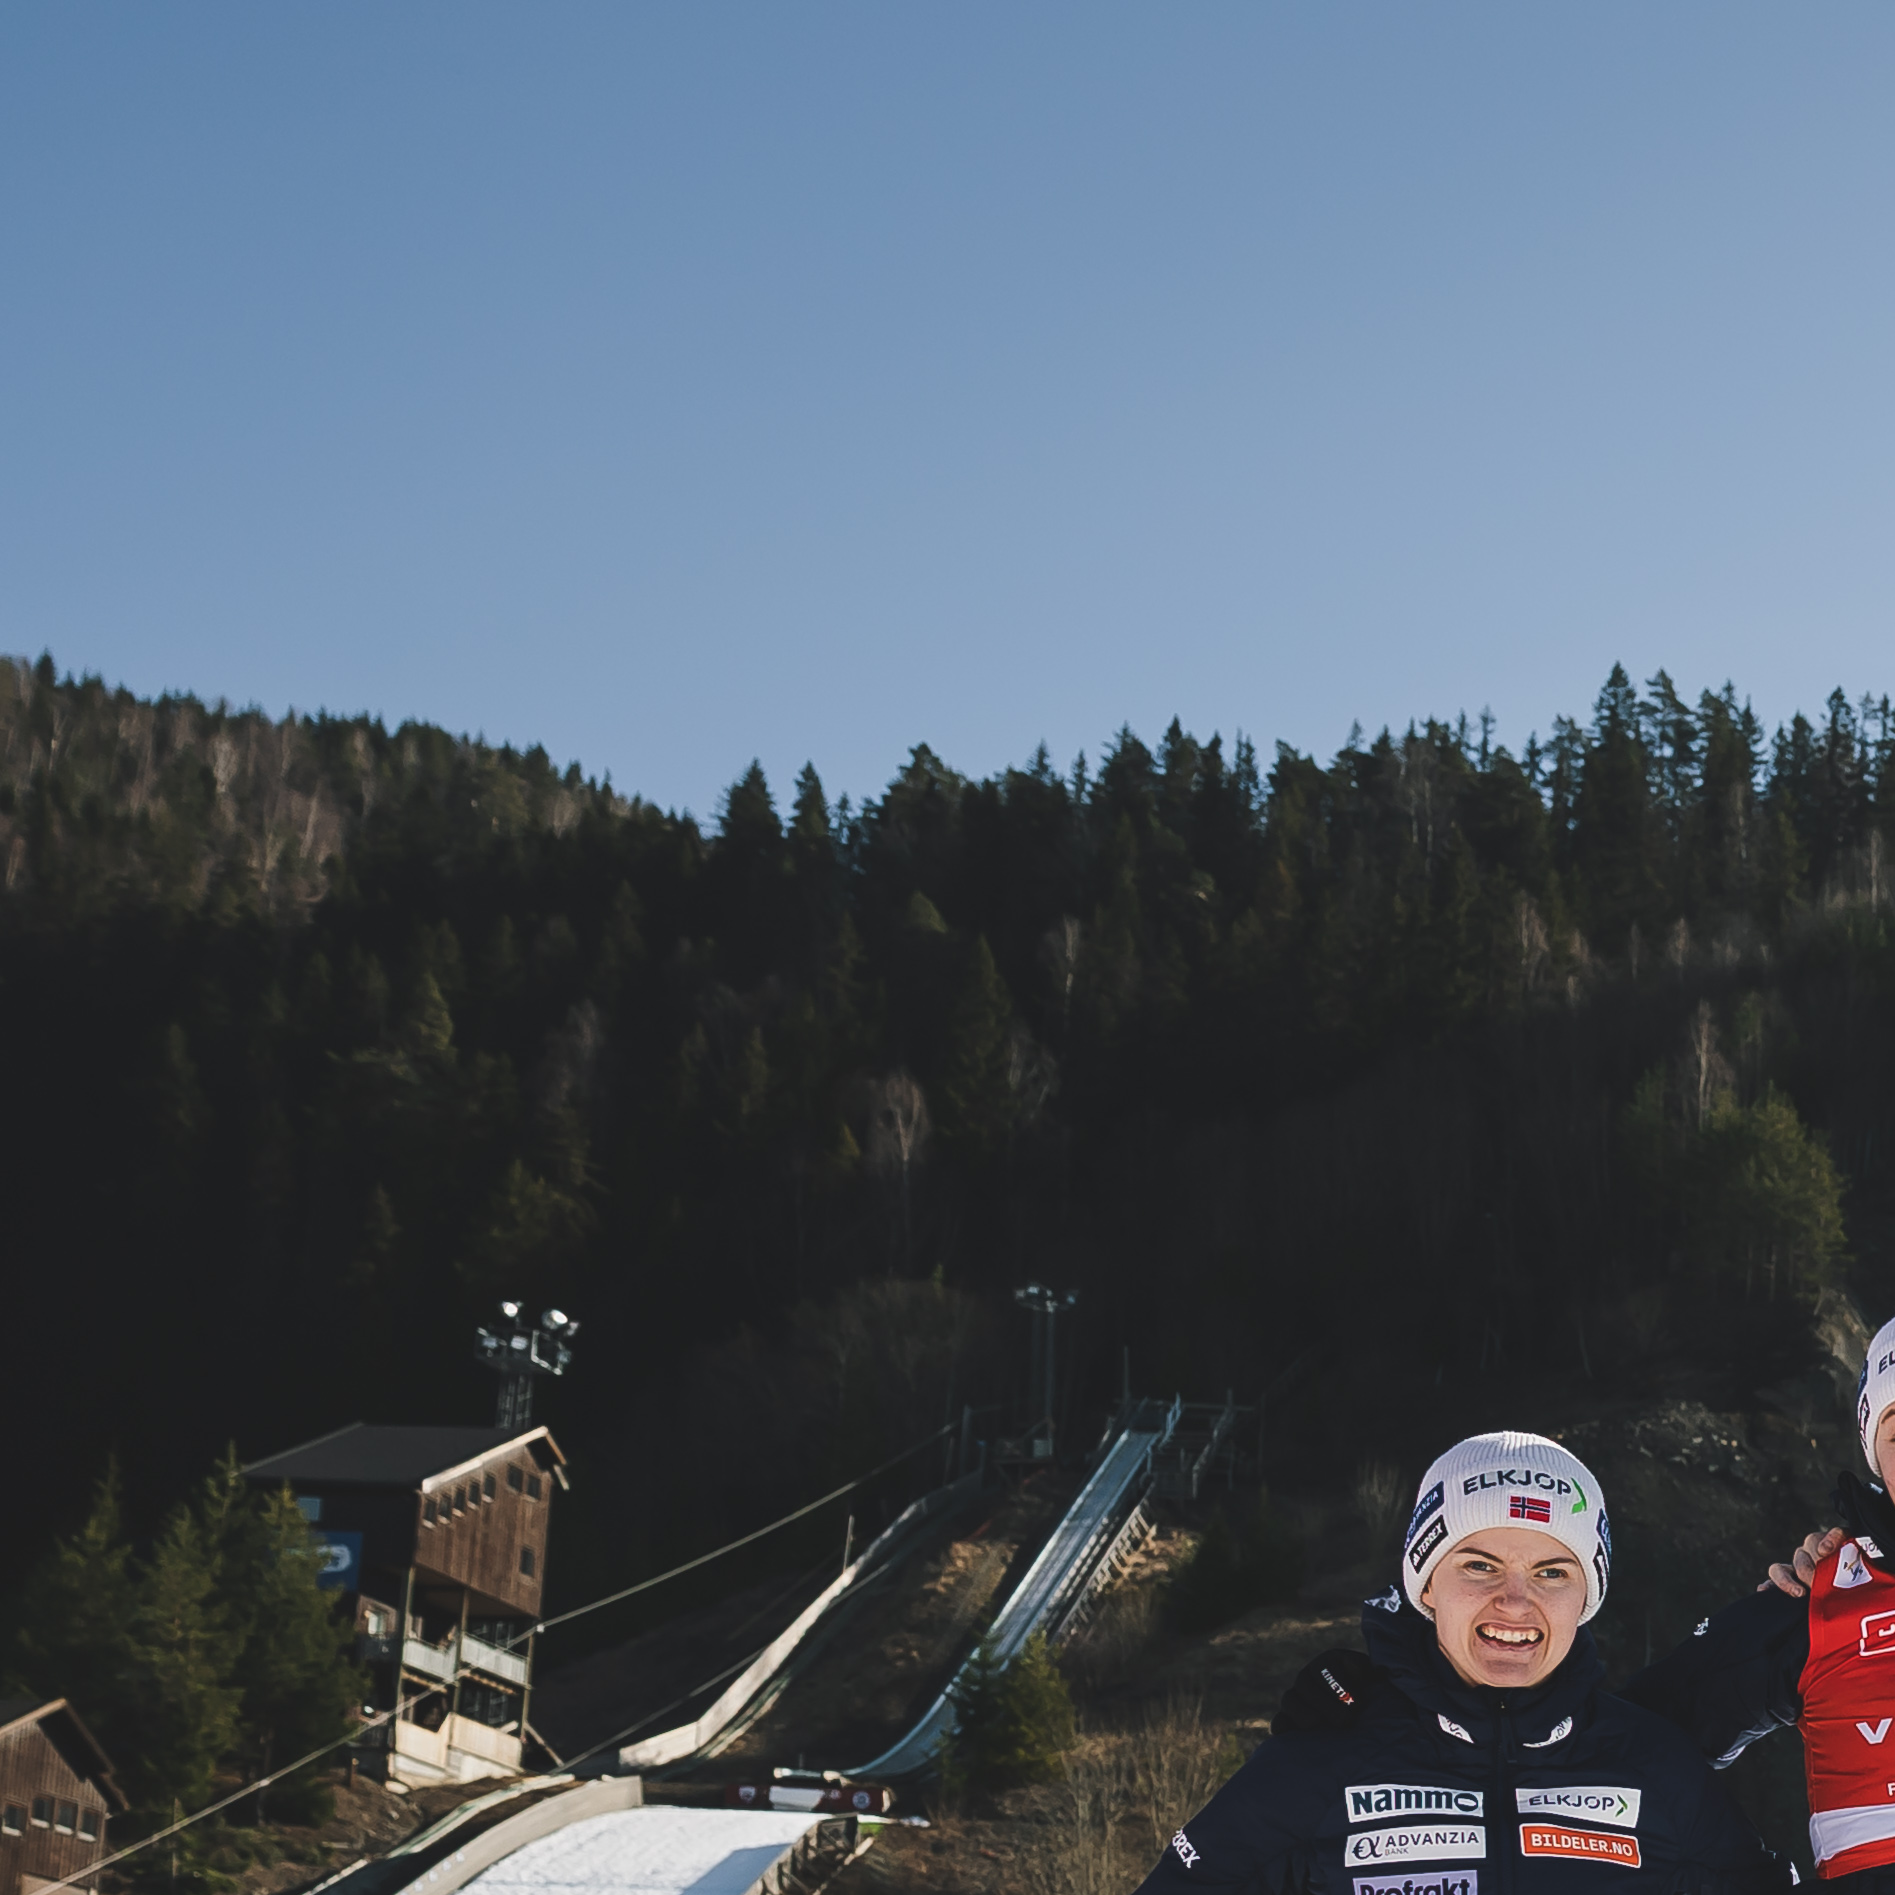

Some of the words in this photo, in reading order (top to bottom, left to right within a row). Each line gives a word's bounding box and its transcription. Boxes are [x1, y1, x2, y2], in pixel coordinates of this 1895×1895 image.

[1351, 1788, 1480, 1816] Nammo
[1385, 1831, 1480, 1849] ADVANZIA
[1530, 1832, 1634, 1858] BILDELER.NO
